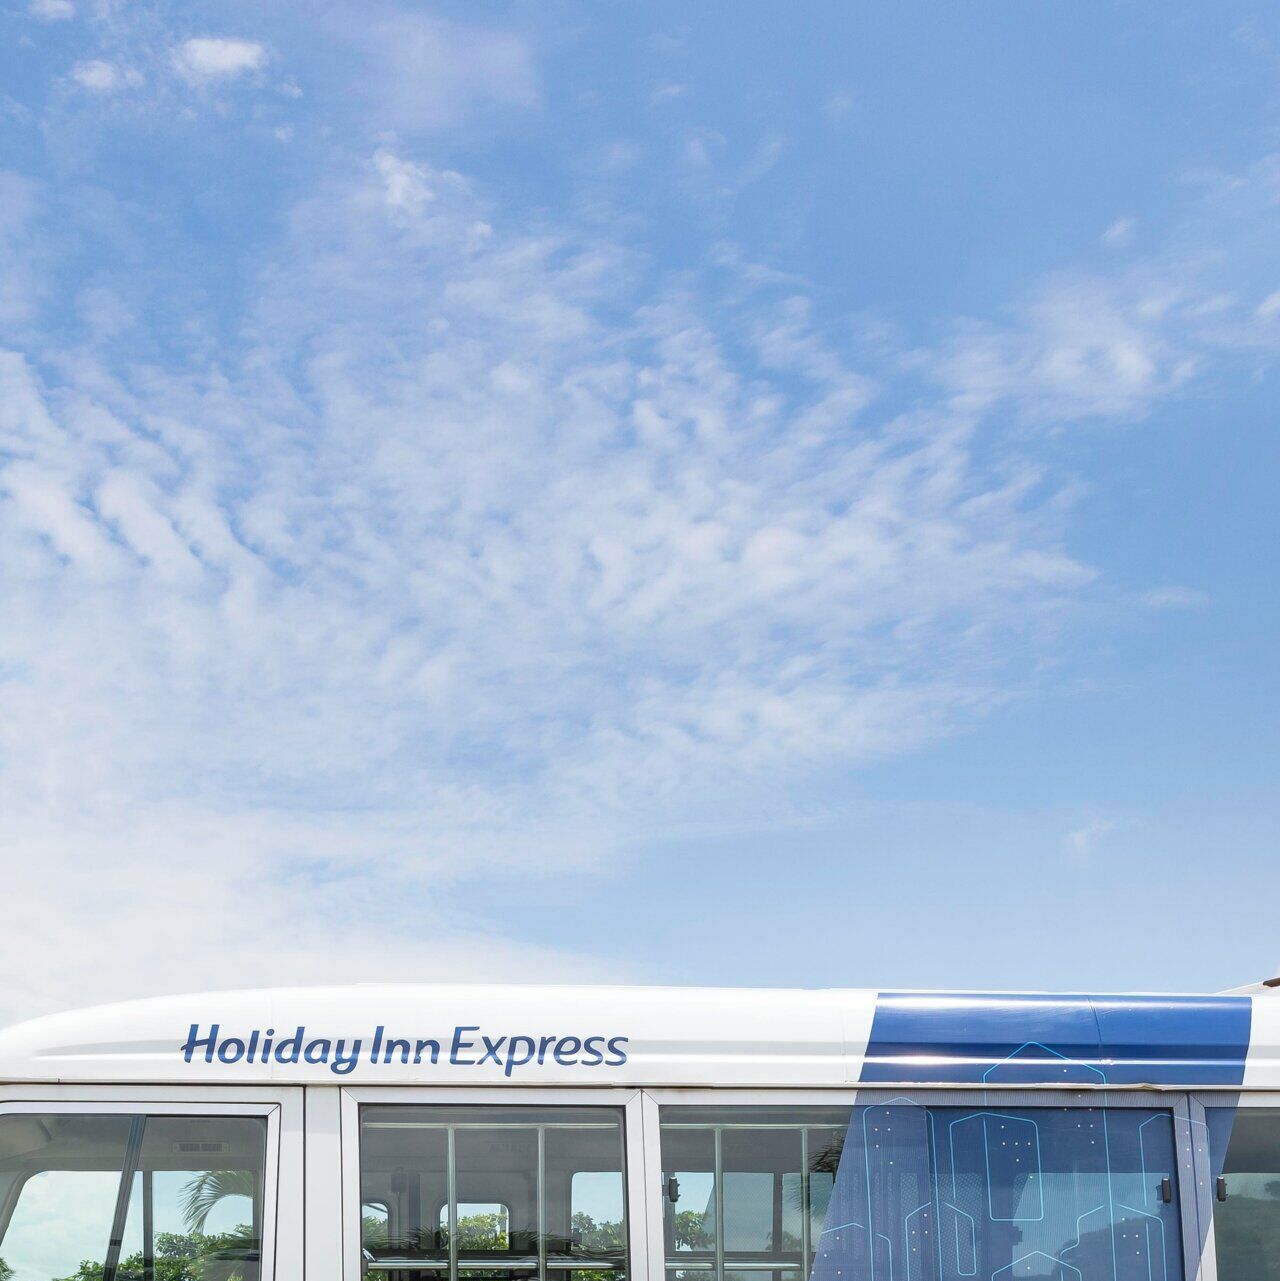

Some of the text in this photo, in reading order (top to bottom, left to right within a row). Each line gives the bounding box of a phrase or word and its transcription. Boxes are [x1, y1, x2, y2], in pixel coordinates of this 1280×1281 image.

[180, 1023, 629, 1077] Holiday Inn Express
